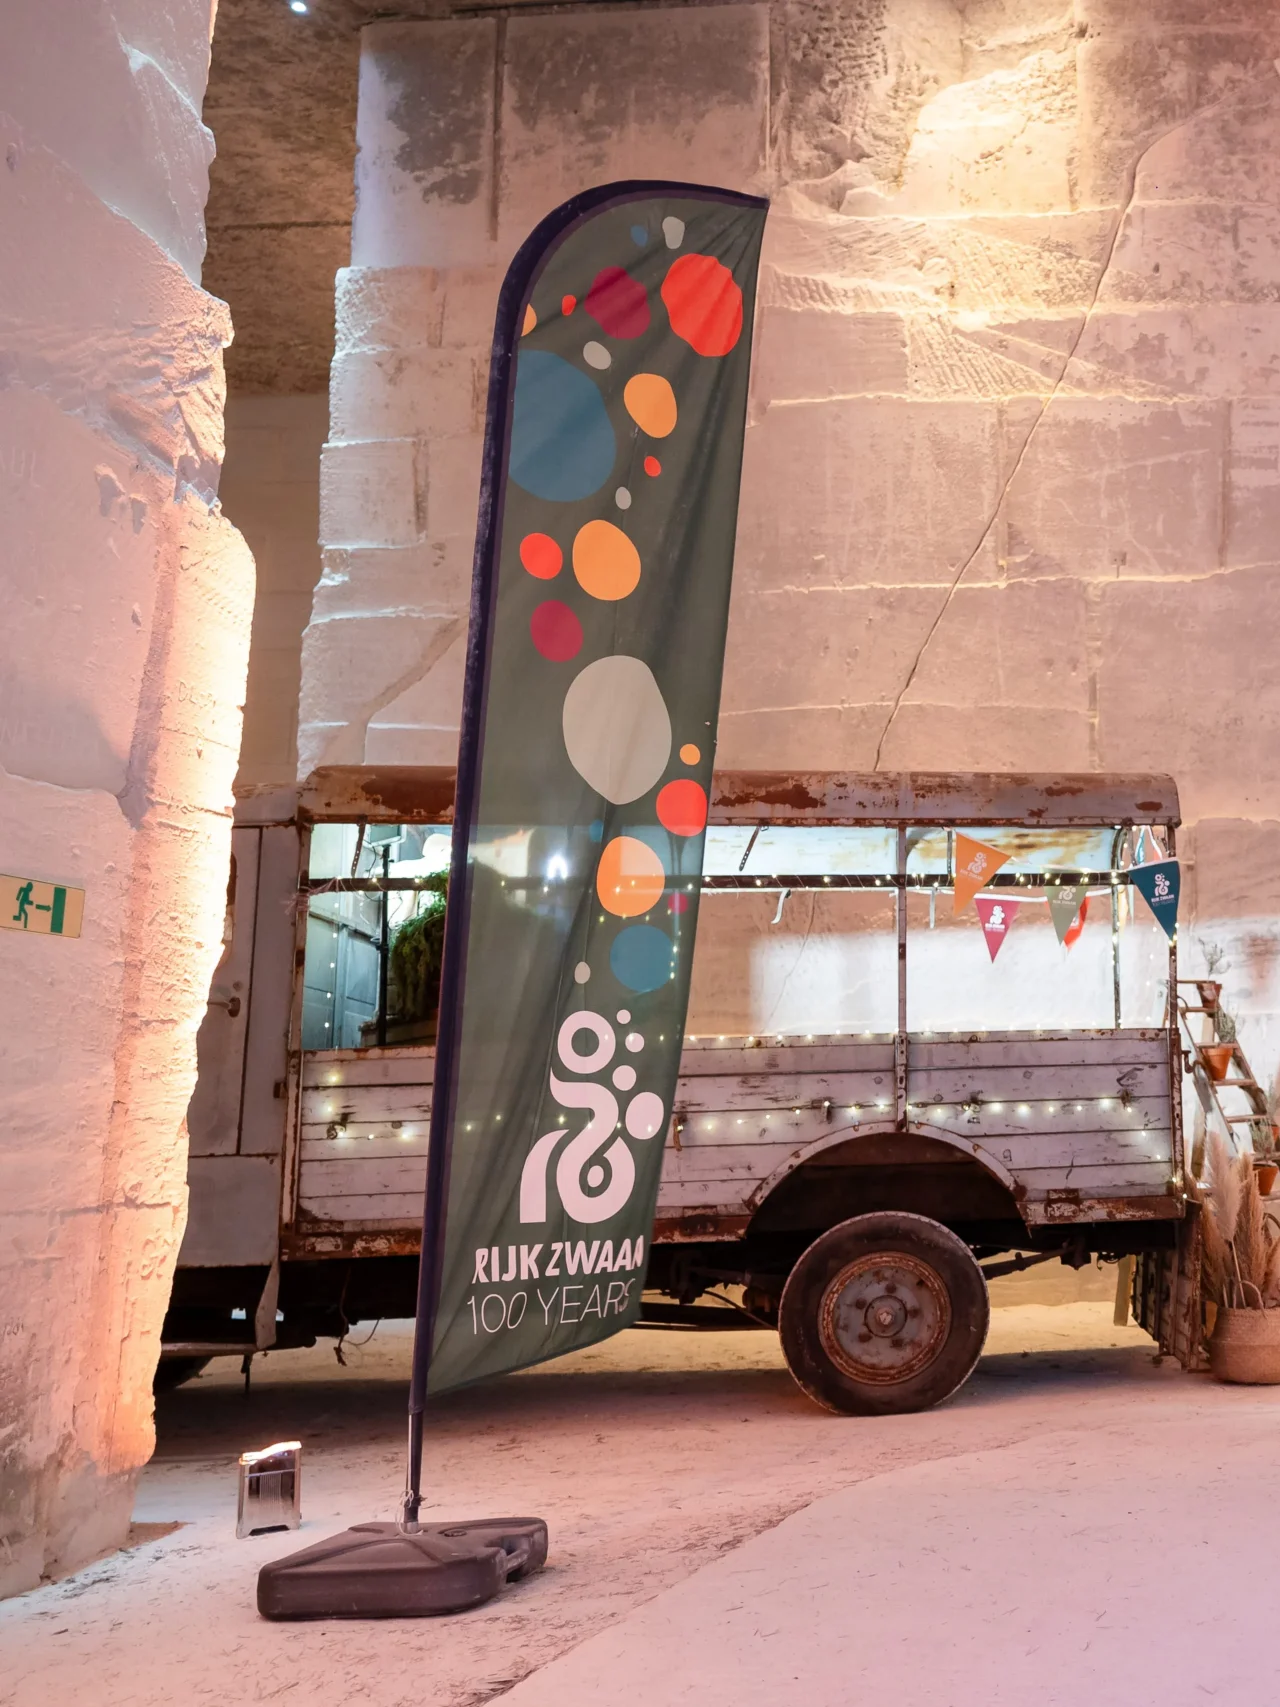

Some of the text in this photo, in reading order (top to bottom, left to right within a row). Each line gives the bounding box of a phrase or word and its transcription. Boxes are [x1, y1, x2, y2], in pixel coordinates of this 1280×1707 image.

[472, 1235, 644, 1284] RIJK ZWAAN
[467, 1278, 636, 1335] 100 YEARS
